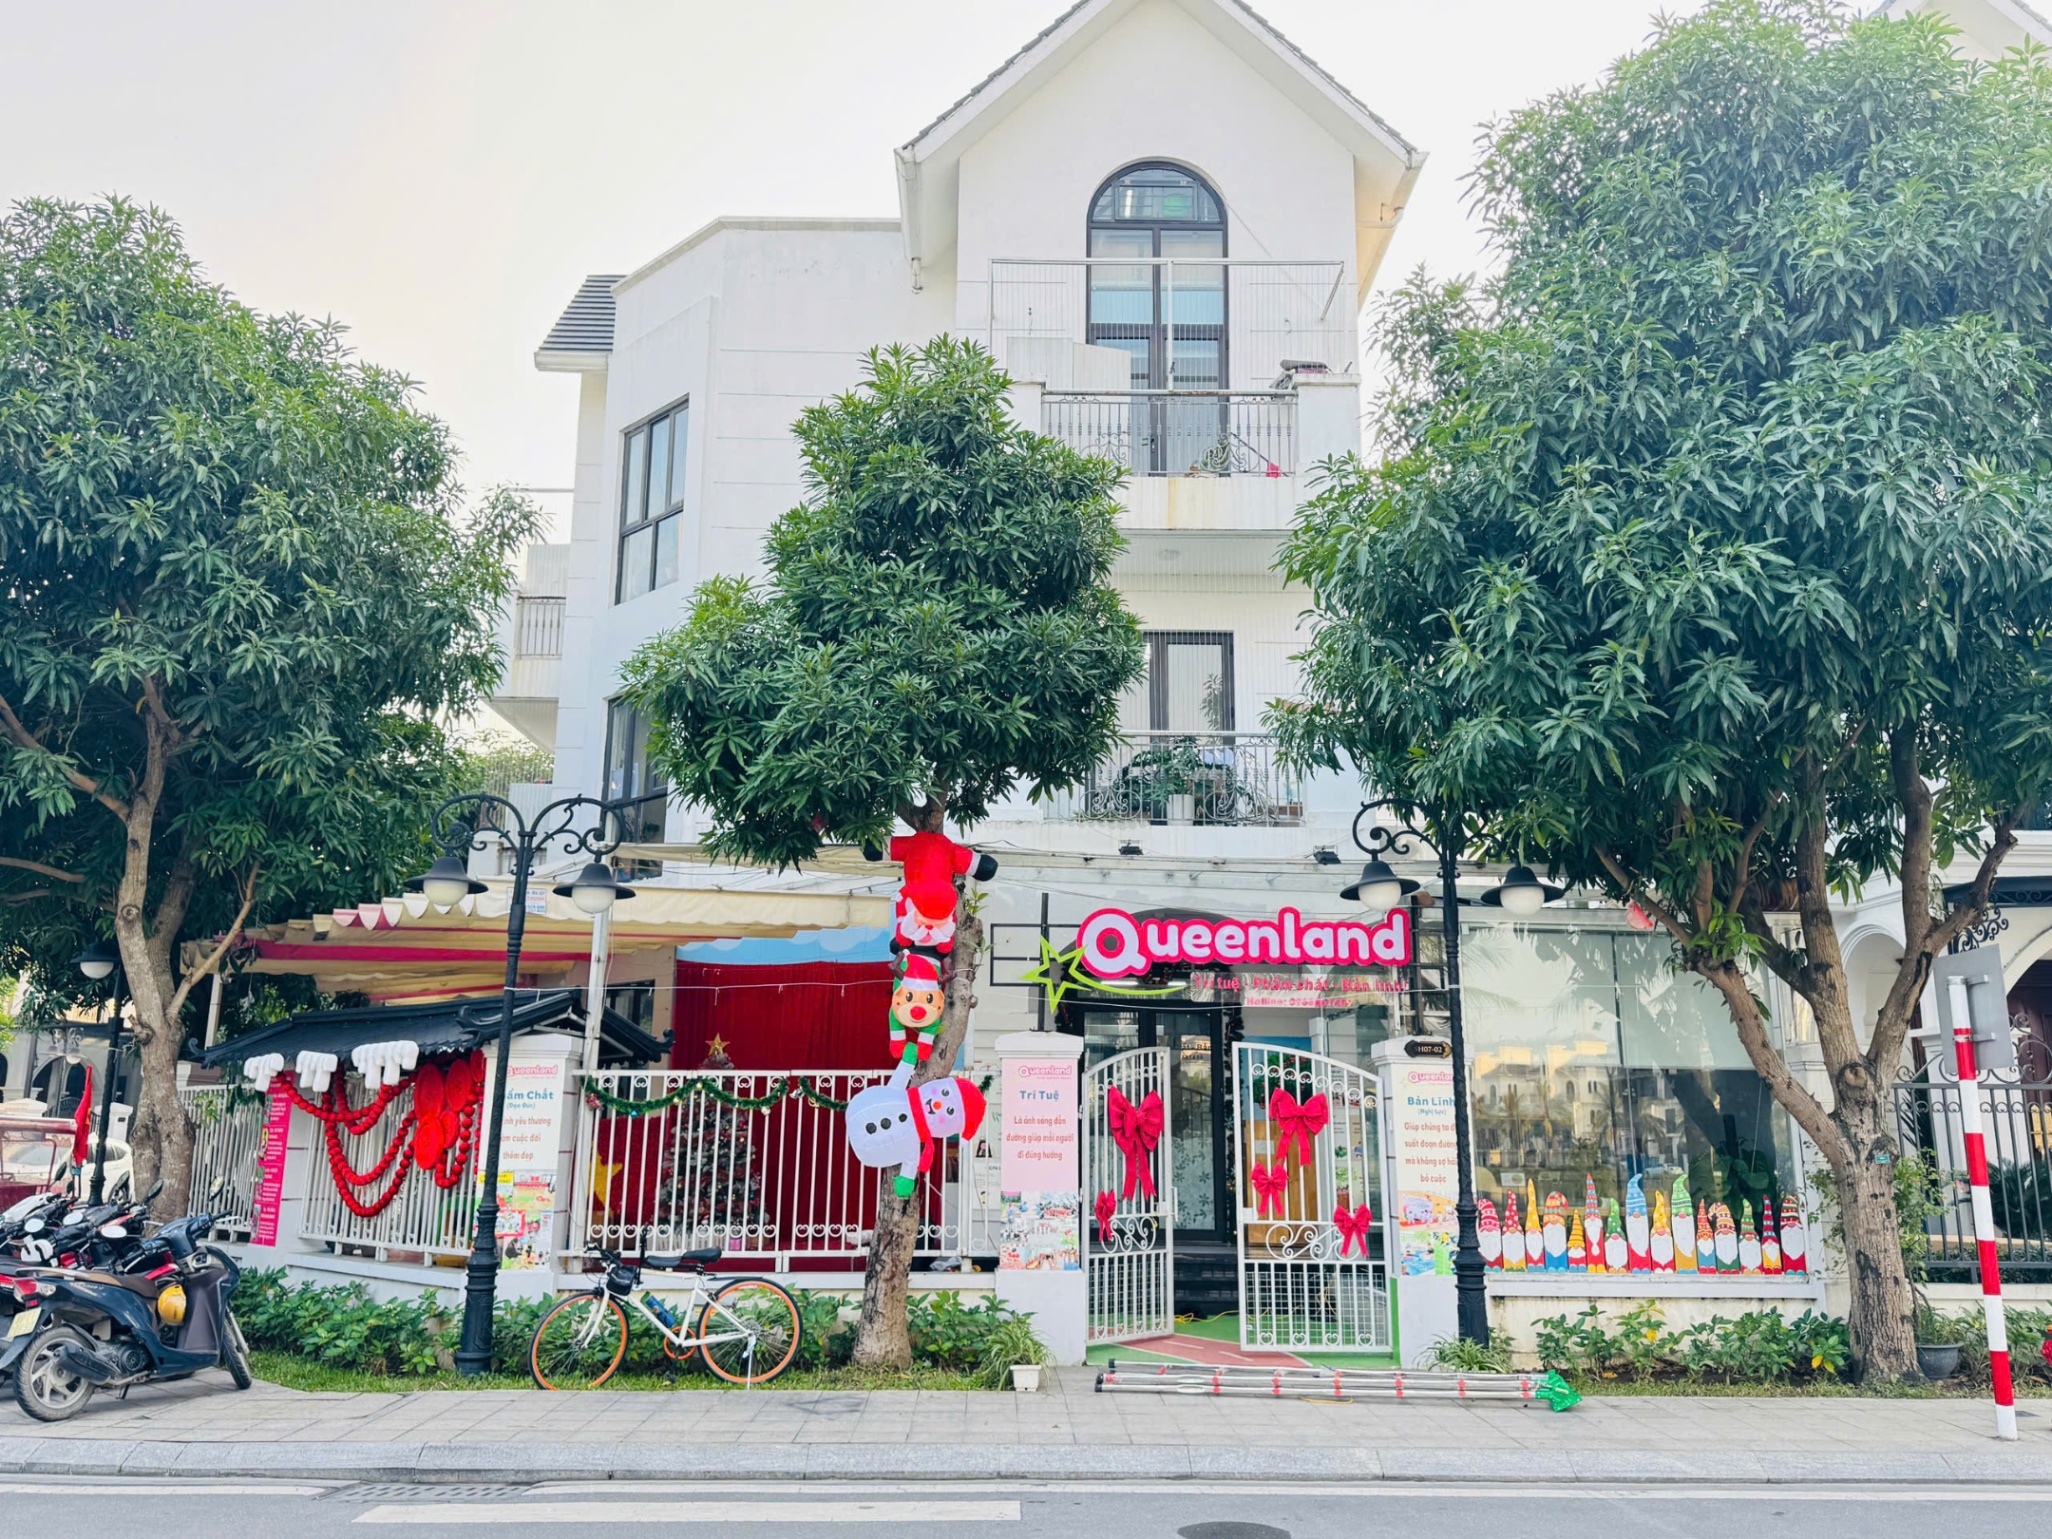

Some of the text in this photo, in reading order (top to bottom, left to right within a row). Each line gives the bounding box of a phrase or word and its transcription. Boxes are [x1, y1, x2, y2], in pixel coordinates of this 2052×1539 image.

[1078, 908, 1410, 977] Queenland
[1018, 1065, 1072, 1077] Queenland
[1019, 1089, 1059, 1102] Trí Tuệ
[1407, 1096, 1429, 1106] Bản
[1014, 1115, 1023, 1124] Là
[1037, 1115, 1052, 1126] sáng
[1404, 1122, 1419, 1132] Giúp
[1421, 1122, 1440, 1132] chúng
[1442, 1123, 1449, 1131] ta
[1417, 1157, 1437, 1167] không
